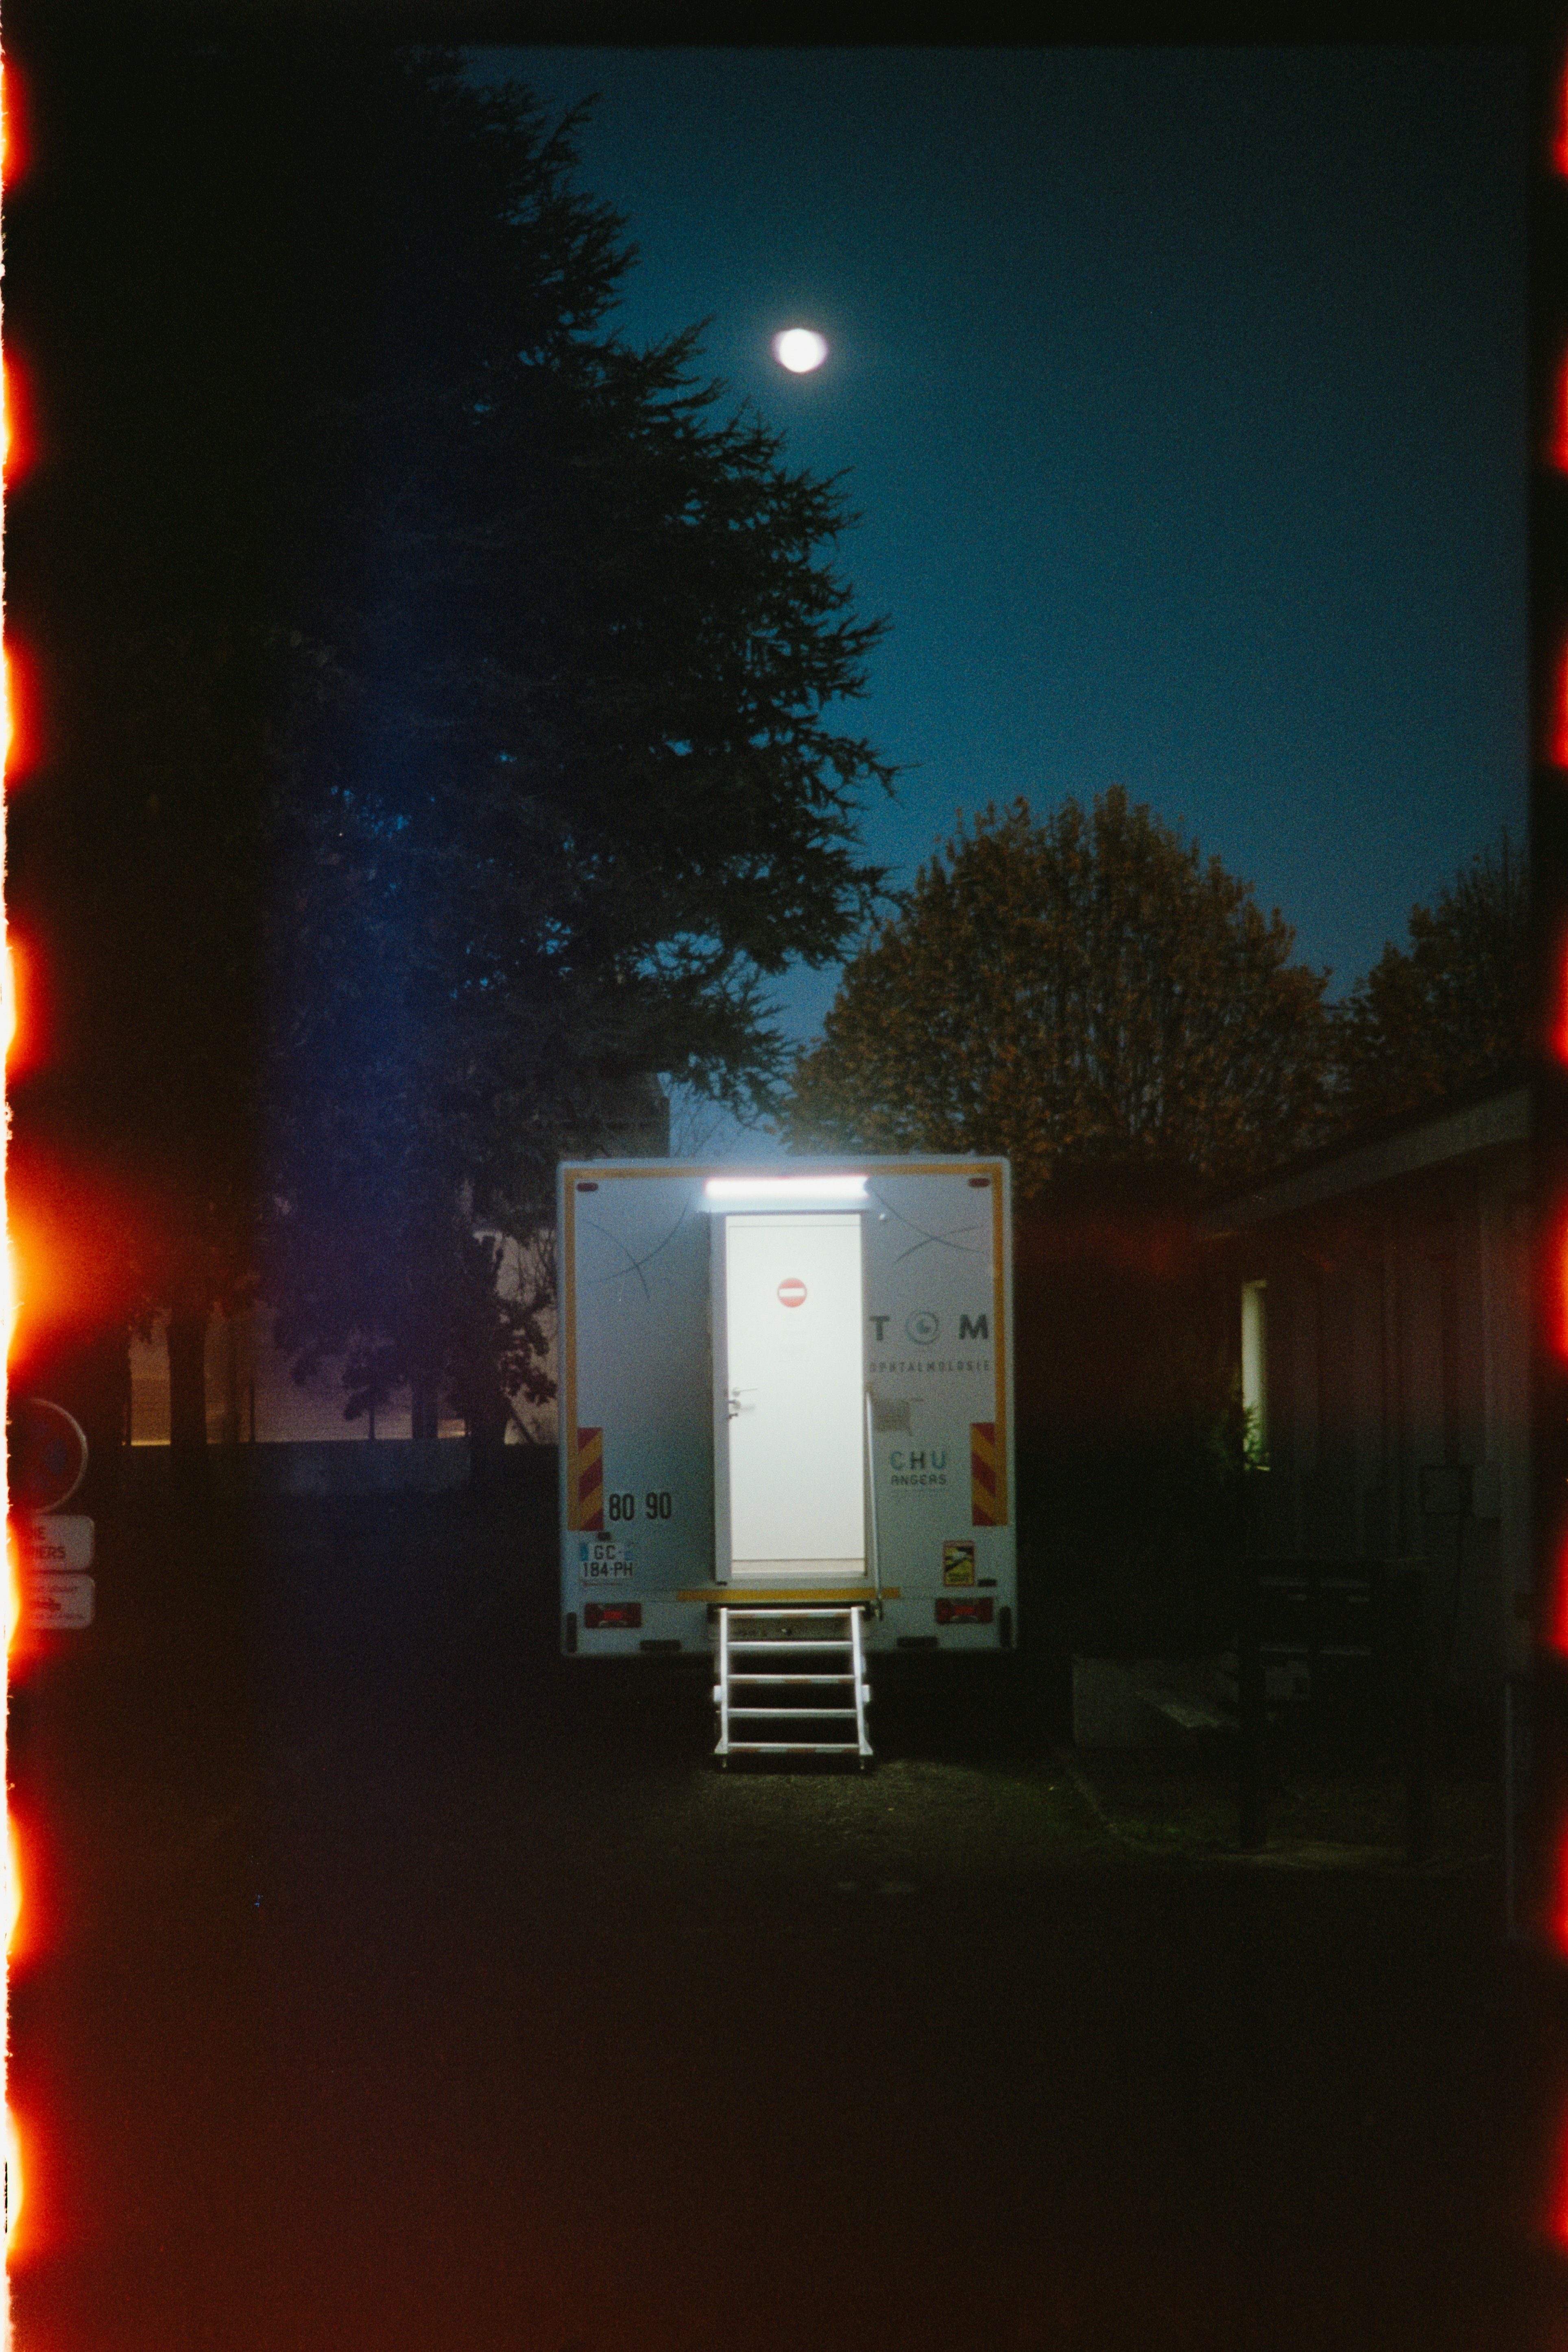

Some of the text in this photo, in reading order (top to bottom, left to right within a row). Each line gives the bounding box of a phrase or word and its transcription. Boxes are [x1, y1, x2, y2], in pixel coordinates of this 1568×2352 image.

[890, 1451, 947, 1471] CHU
[891, 1474, 947, 1486] ANGERS
[610, 1492, 672, 1521] 80 90
[583, 1561, 633, 1577] 184-PH
